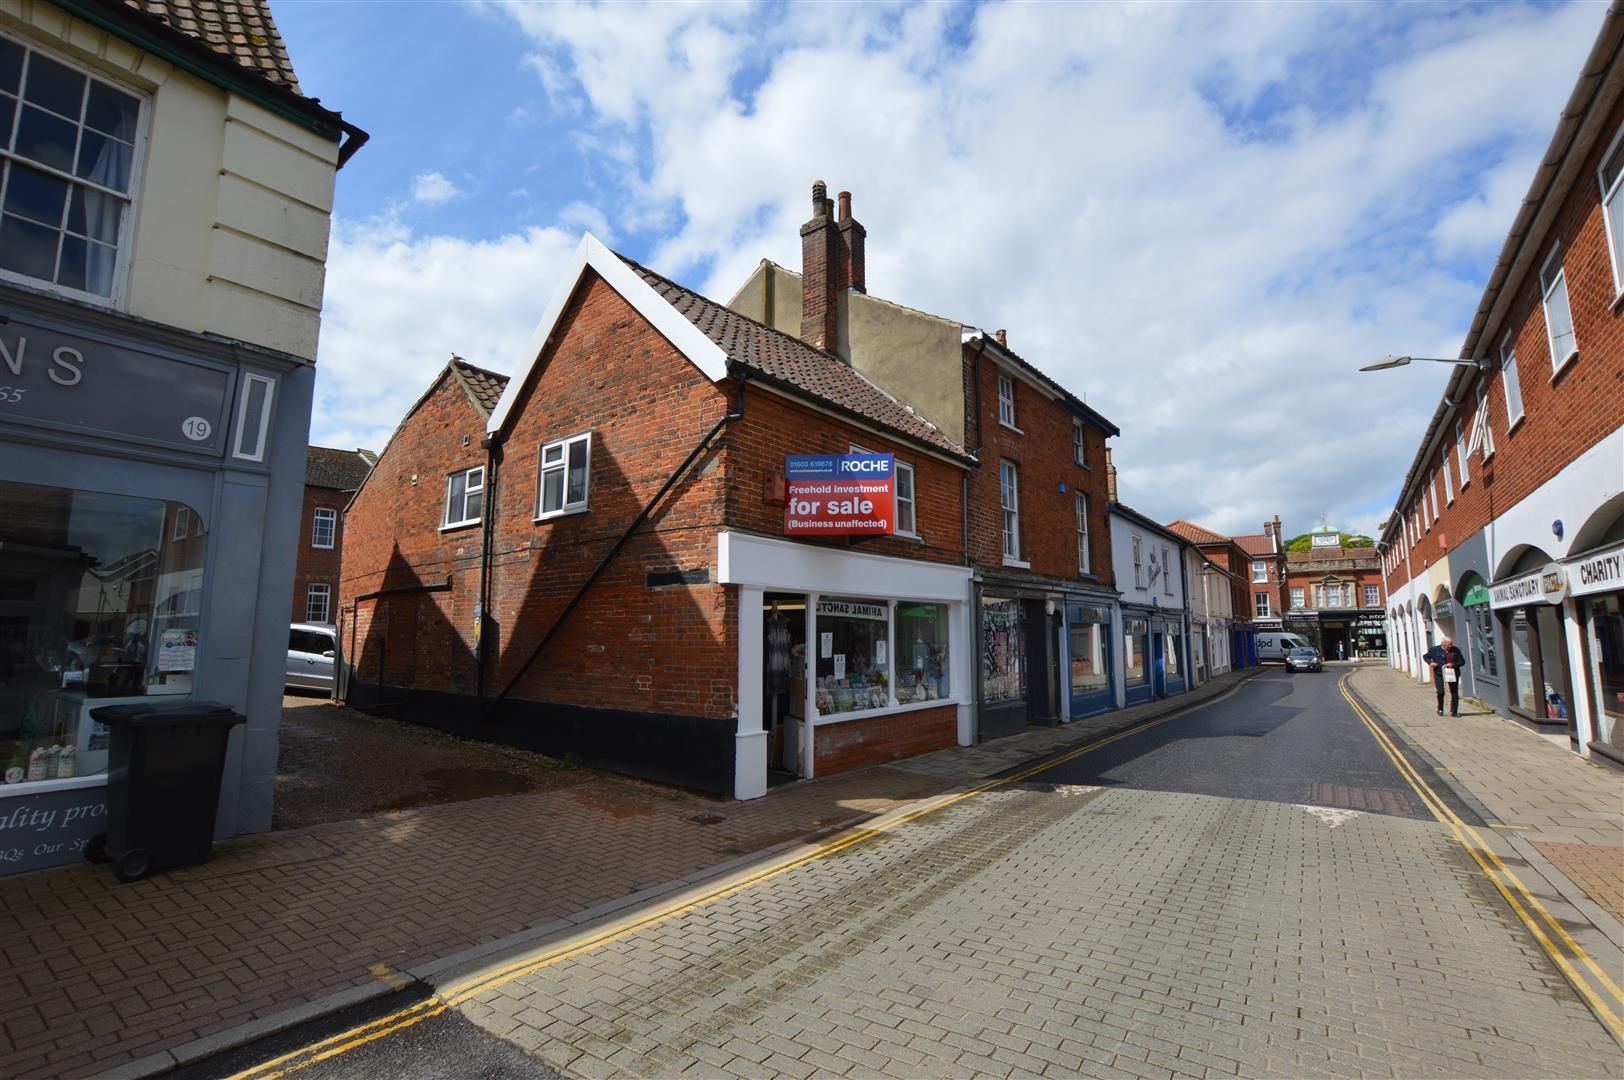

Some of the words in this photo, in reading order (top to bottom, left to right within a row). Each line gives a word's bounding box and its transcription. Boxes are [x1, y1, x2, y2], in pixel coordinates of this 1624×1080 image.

[186, 419, 208, 438] 19
[841, 460, 889, 472] ROCHE
[789, 485, 832, 494] Freehold
[834, 484, 889, 493] investment
[789, 497, 820, 515] for
[827, 497, 873, 515] sale
[788, 520, 834, 529] (Business
[835, 519, 888, 529] unaffected)
[1580, 555, 1621, 586] CHARITY
[1509, 579, 1540, 600] SANCTUARY
[1256, 638, 1273, 649] dpd
[61, 803, 108, 828] pro
[33, 843, 65, 856] Our
